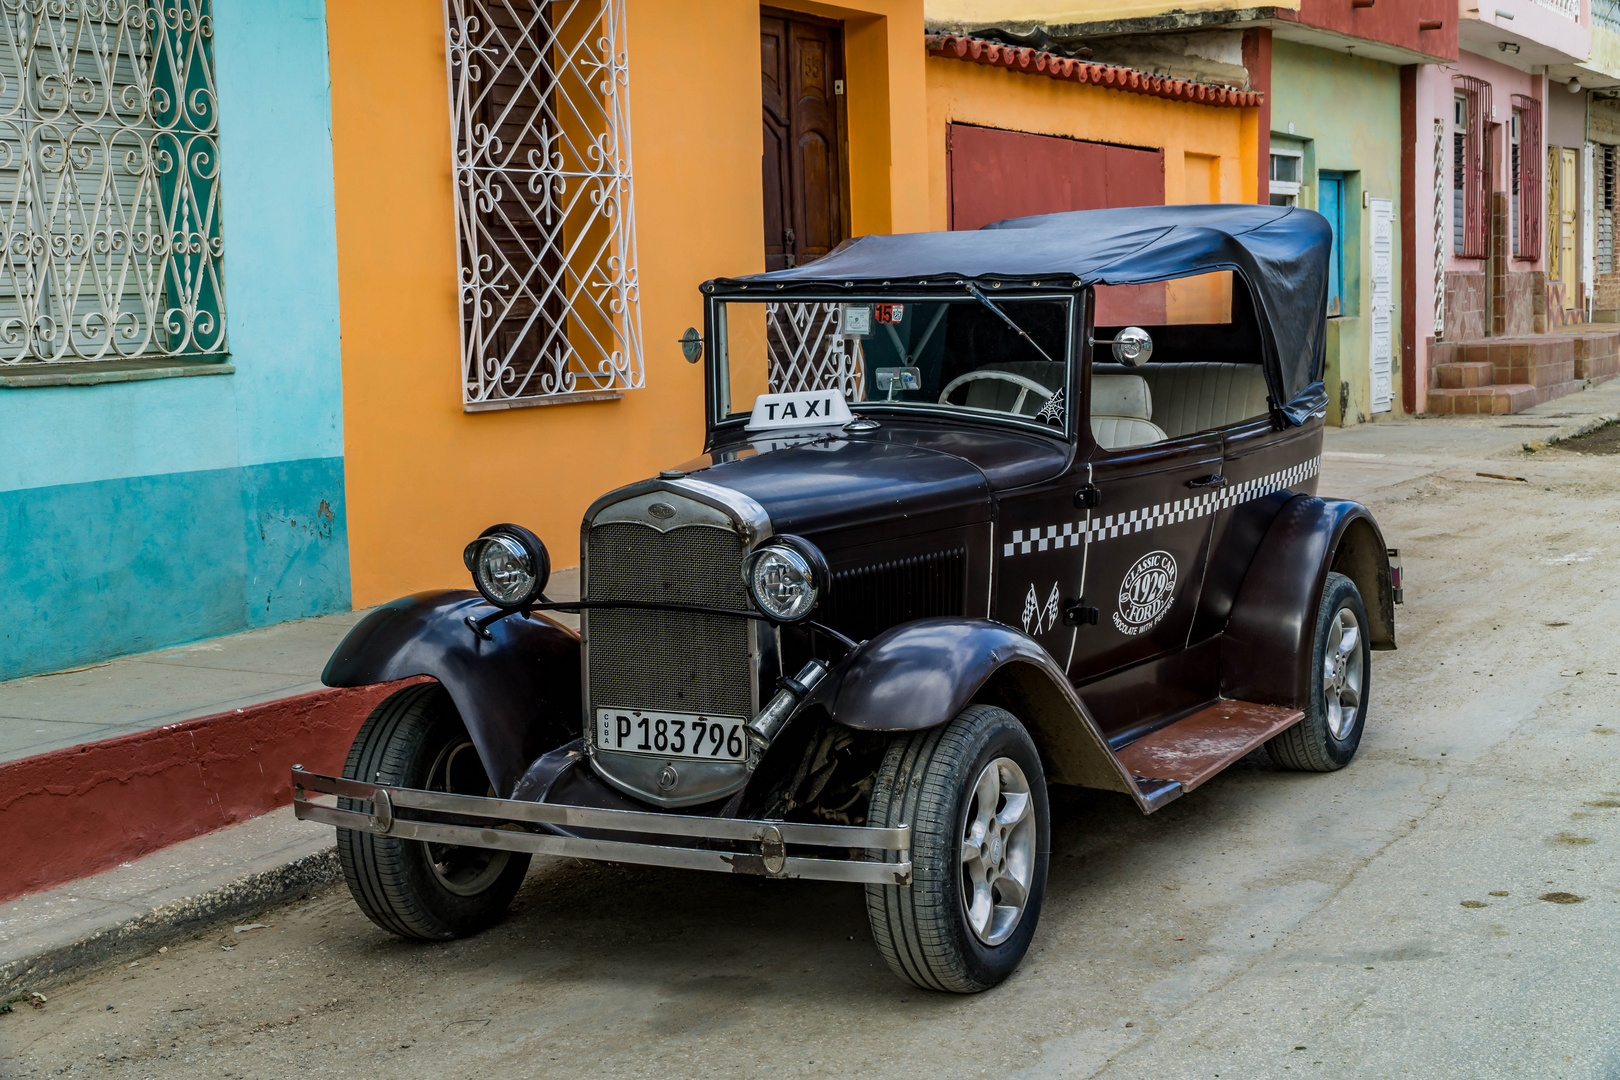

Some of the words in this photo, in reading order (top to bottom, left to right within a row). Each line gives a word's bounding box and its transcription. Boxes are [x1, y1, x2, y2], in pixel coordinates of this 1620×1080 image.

[876, 305, 892, 323] 15
[764, 399, 831, 420] TAXI
[1124, 555, 1161, 589] CLASSIC
[1161, 557, 1175, 580] CAR
[1132, 572, 1166, 603] 1929
[1112, 611, 1138, 635] CHOCOLATE
[1138, 620, 1154, 634] WITH
[1154, 596, 1175, 625] PEPPER
[1128, 599, 1161, 622] FORD
